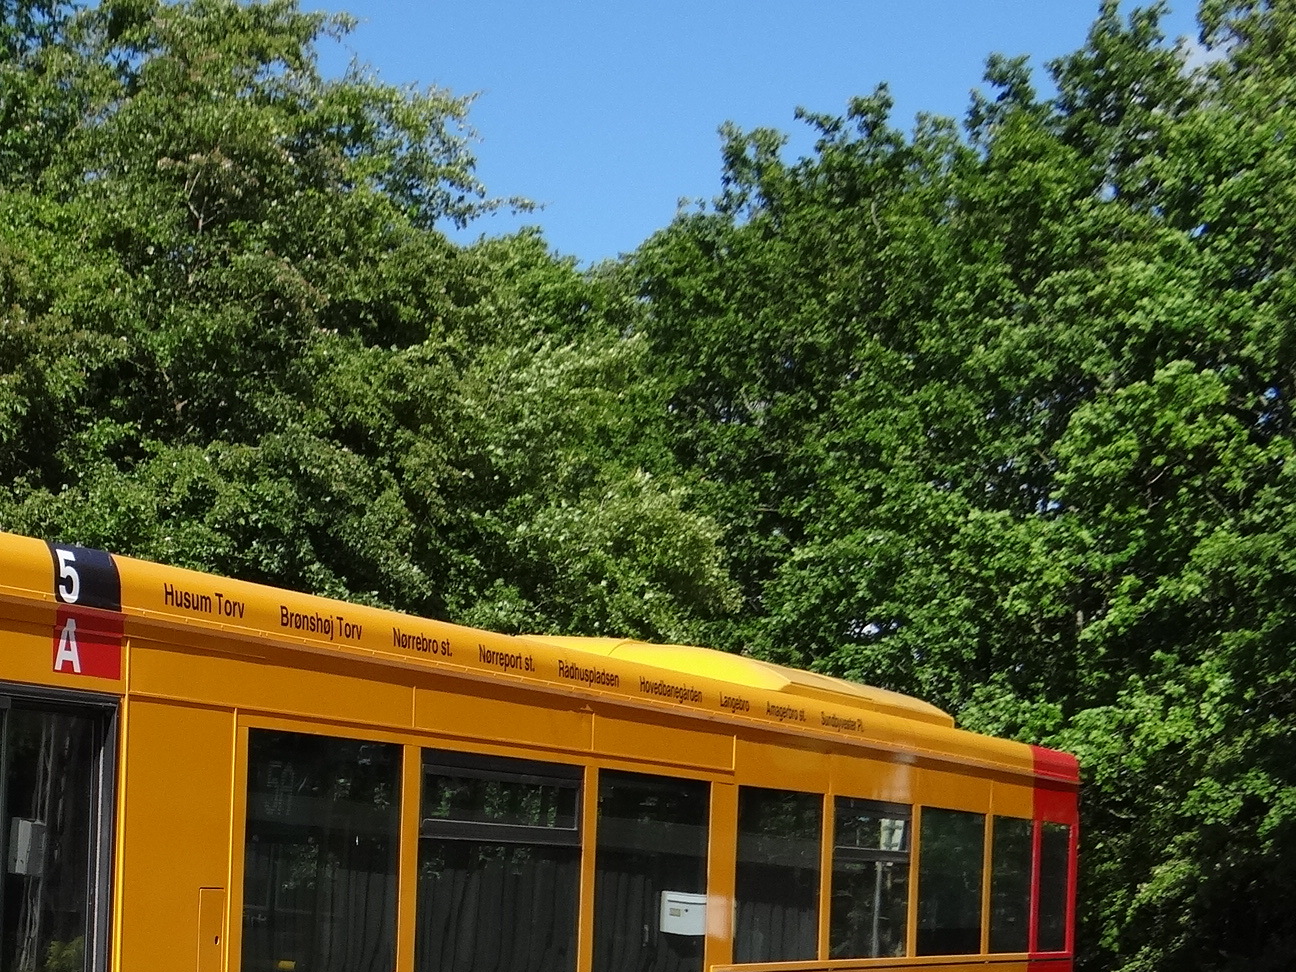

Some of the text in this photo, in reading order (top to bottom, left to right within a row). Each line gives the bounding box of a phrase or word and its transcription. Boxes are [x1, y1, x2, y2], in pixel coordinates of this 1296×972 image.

[56, 549, 80, 604] 5
[164, 583, 245, 619] Husum Torv
[280, 606, 363, 640] Brønshøj Torv
[54, 617, 82, 673] A
[393, 627, 453, 657] Nørrebro st.
[478, 644, 535, 672] Nørreport st.
[558, 659, 620, 688] Rådhuspladsen
[639, 676, 703, 704] Hovedbanegården
[719, 691, 750, 713] Langebro
